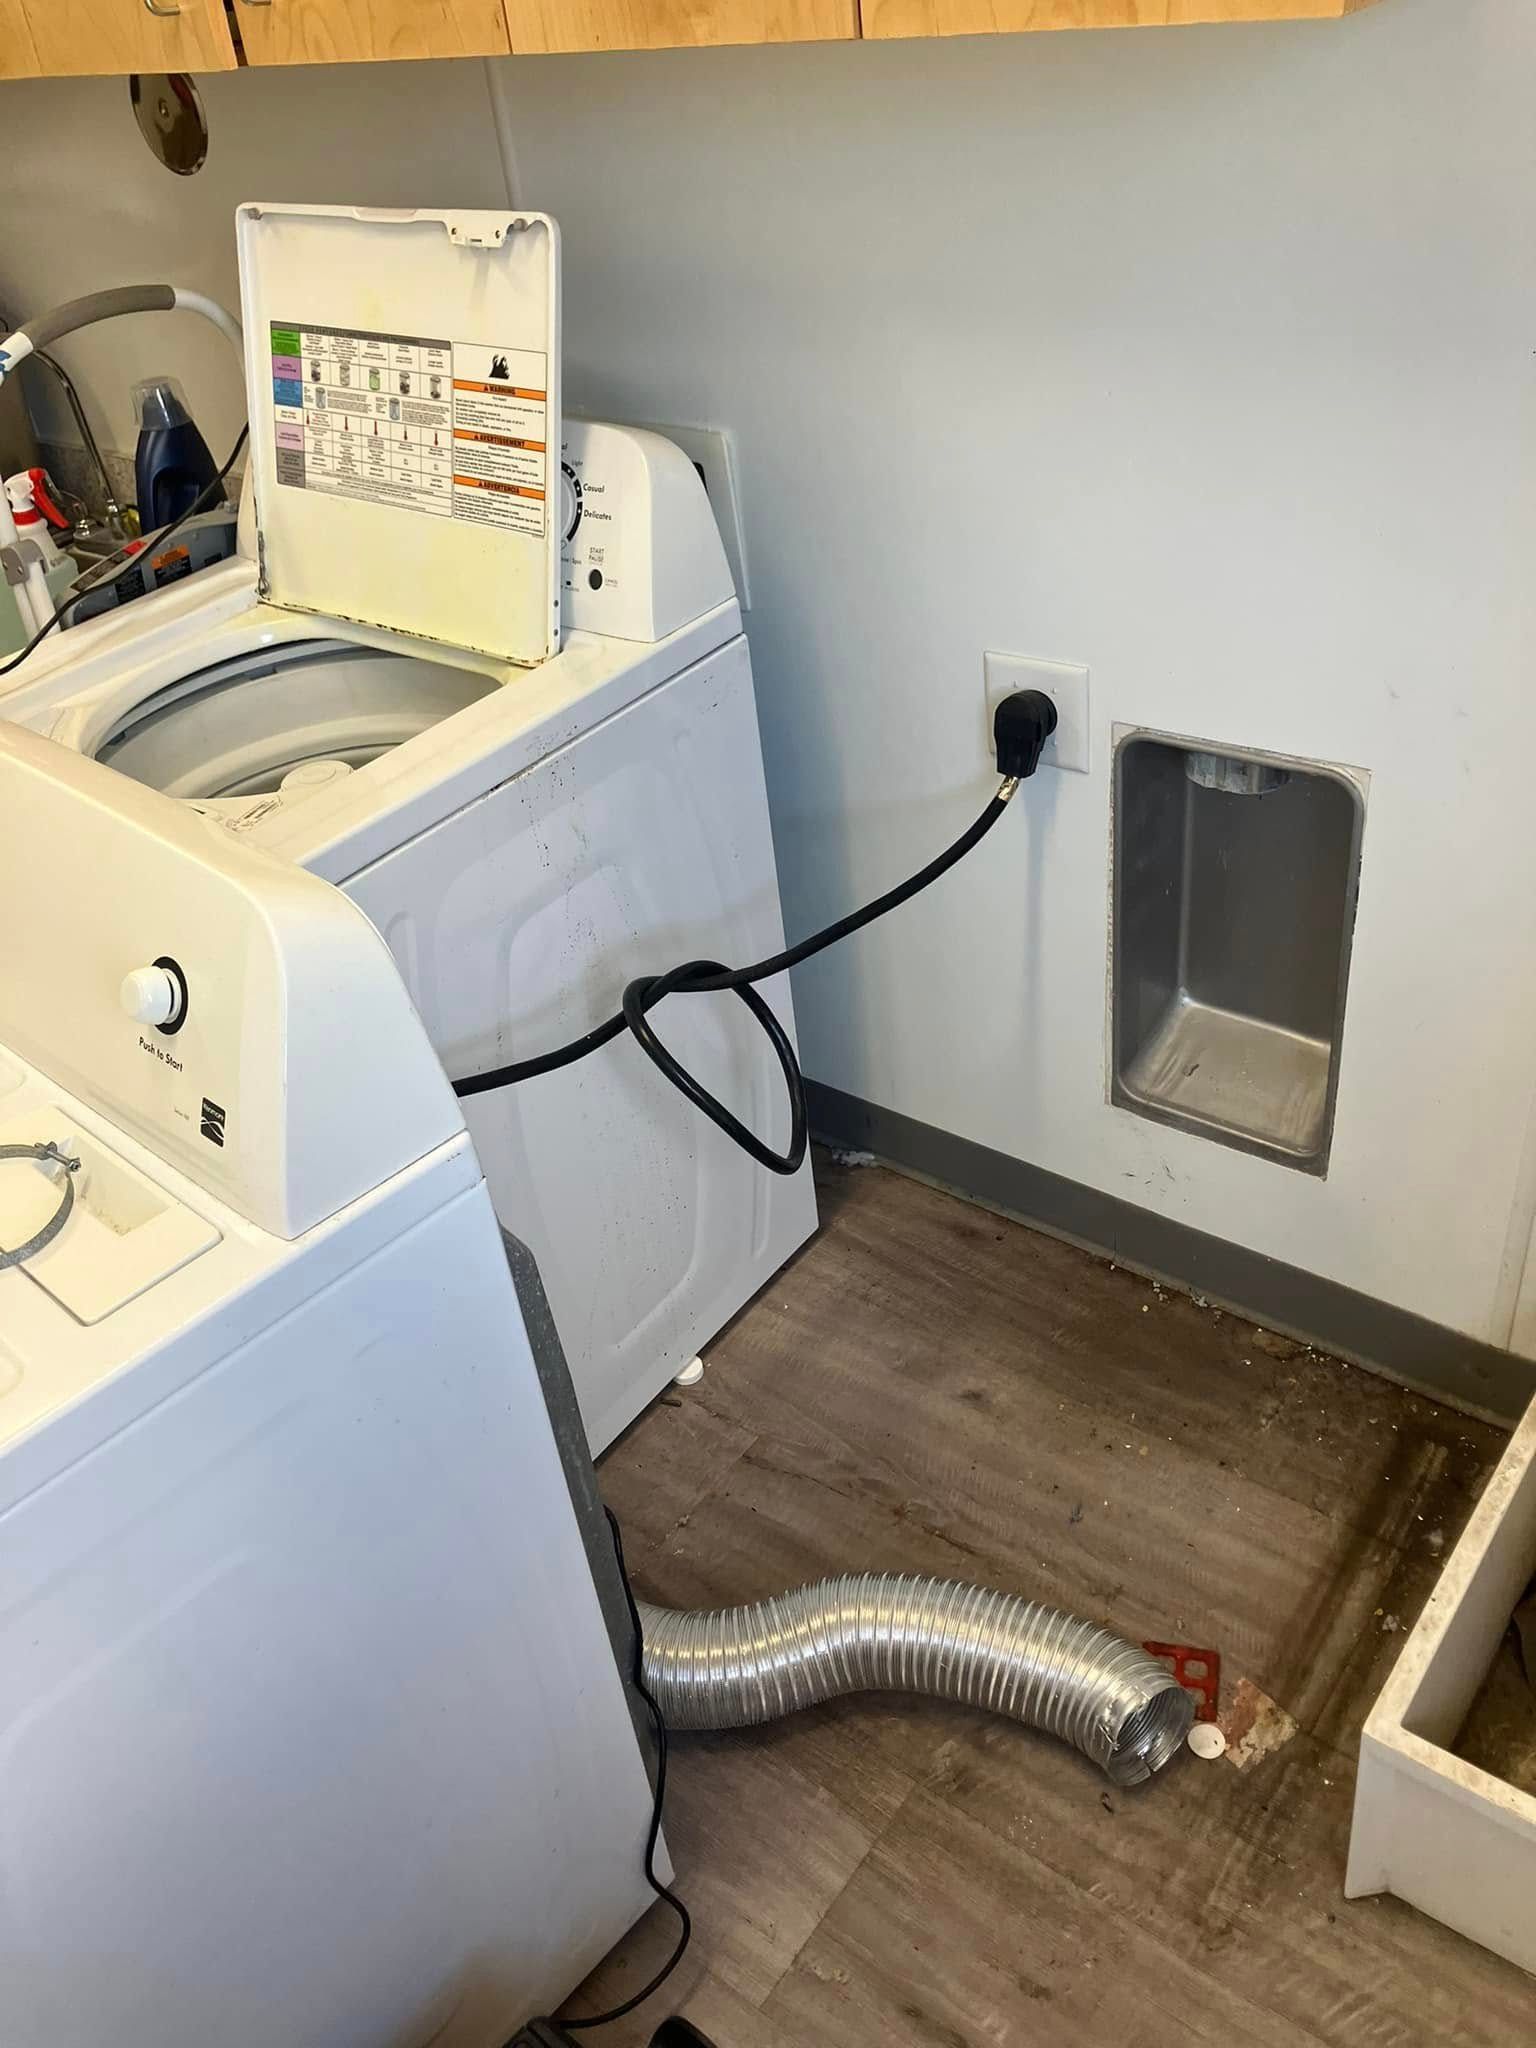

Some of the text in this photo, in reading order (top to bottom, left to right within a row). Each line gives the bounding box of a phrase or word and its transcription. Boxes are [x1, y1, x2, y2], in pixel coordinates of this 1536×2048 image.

[490, 385, 516, 395] WARNING
[583, 483, 605, 493] Casual
[584, 510, 612, 521] Delicates
[139, 1036, 184, 1072] Push to Start
